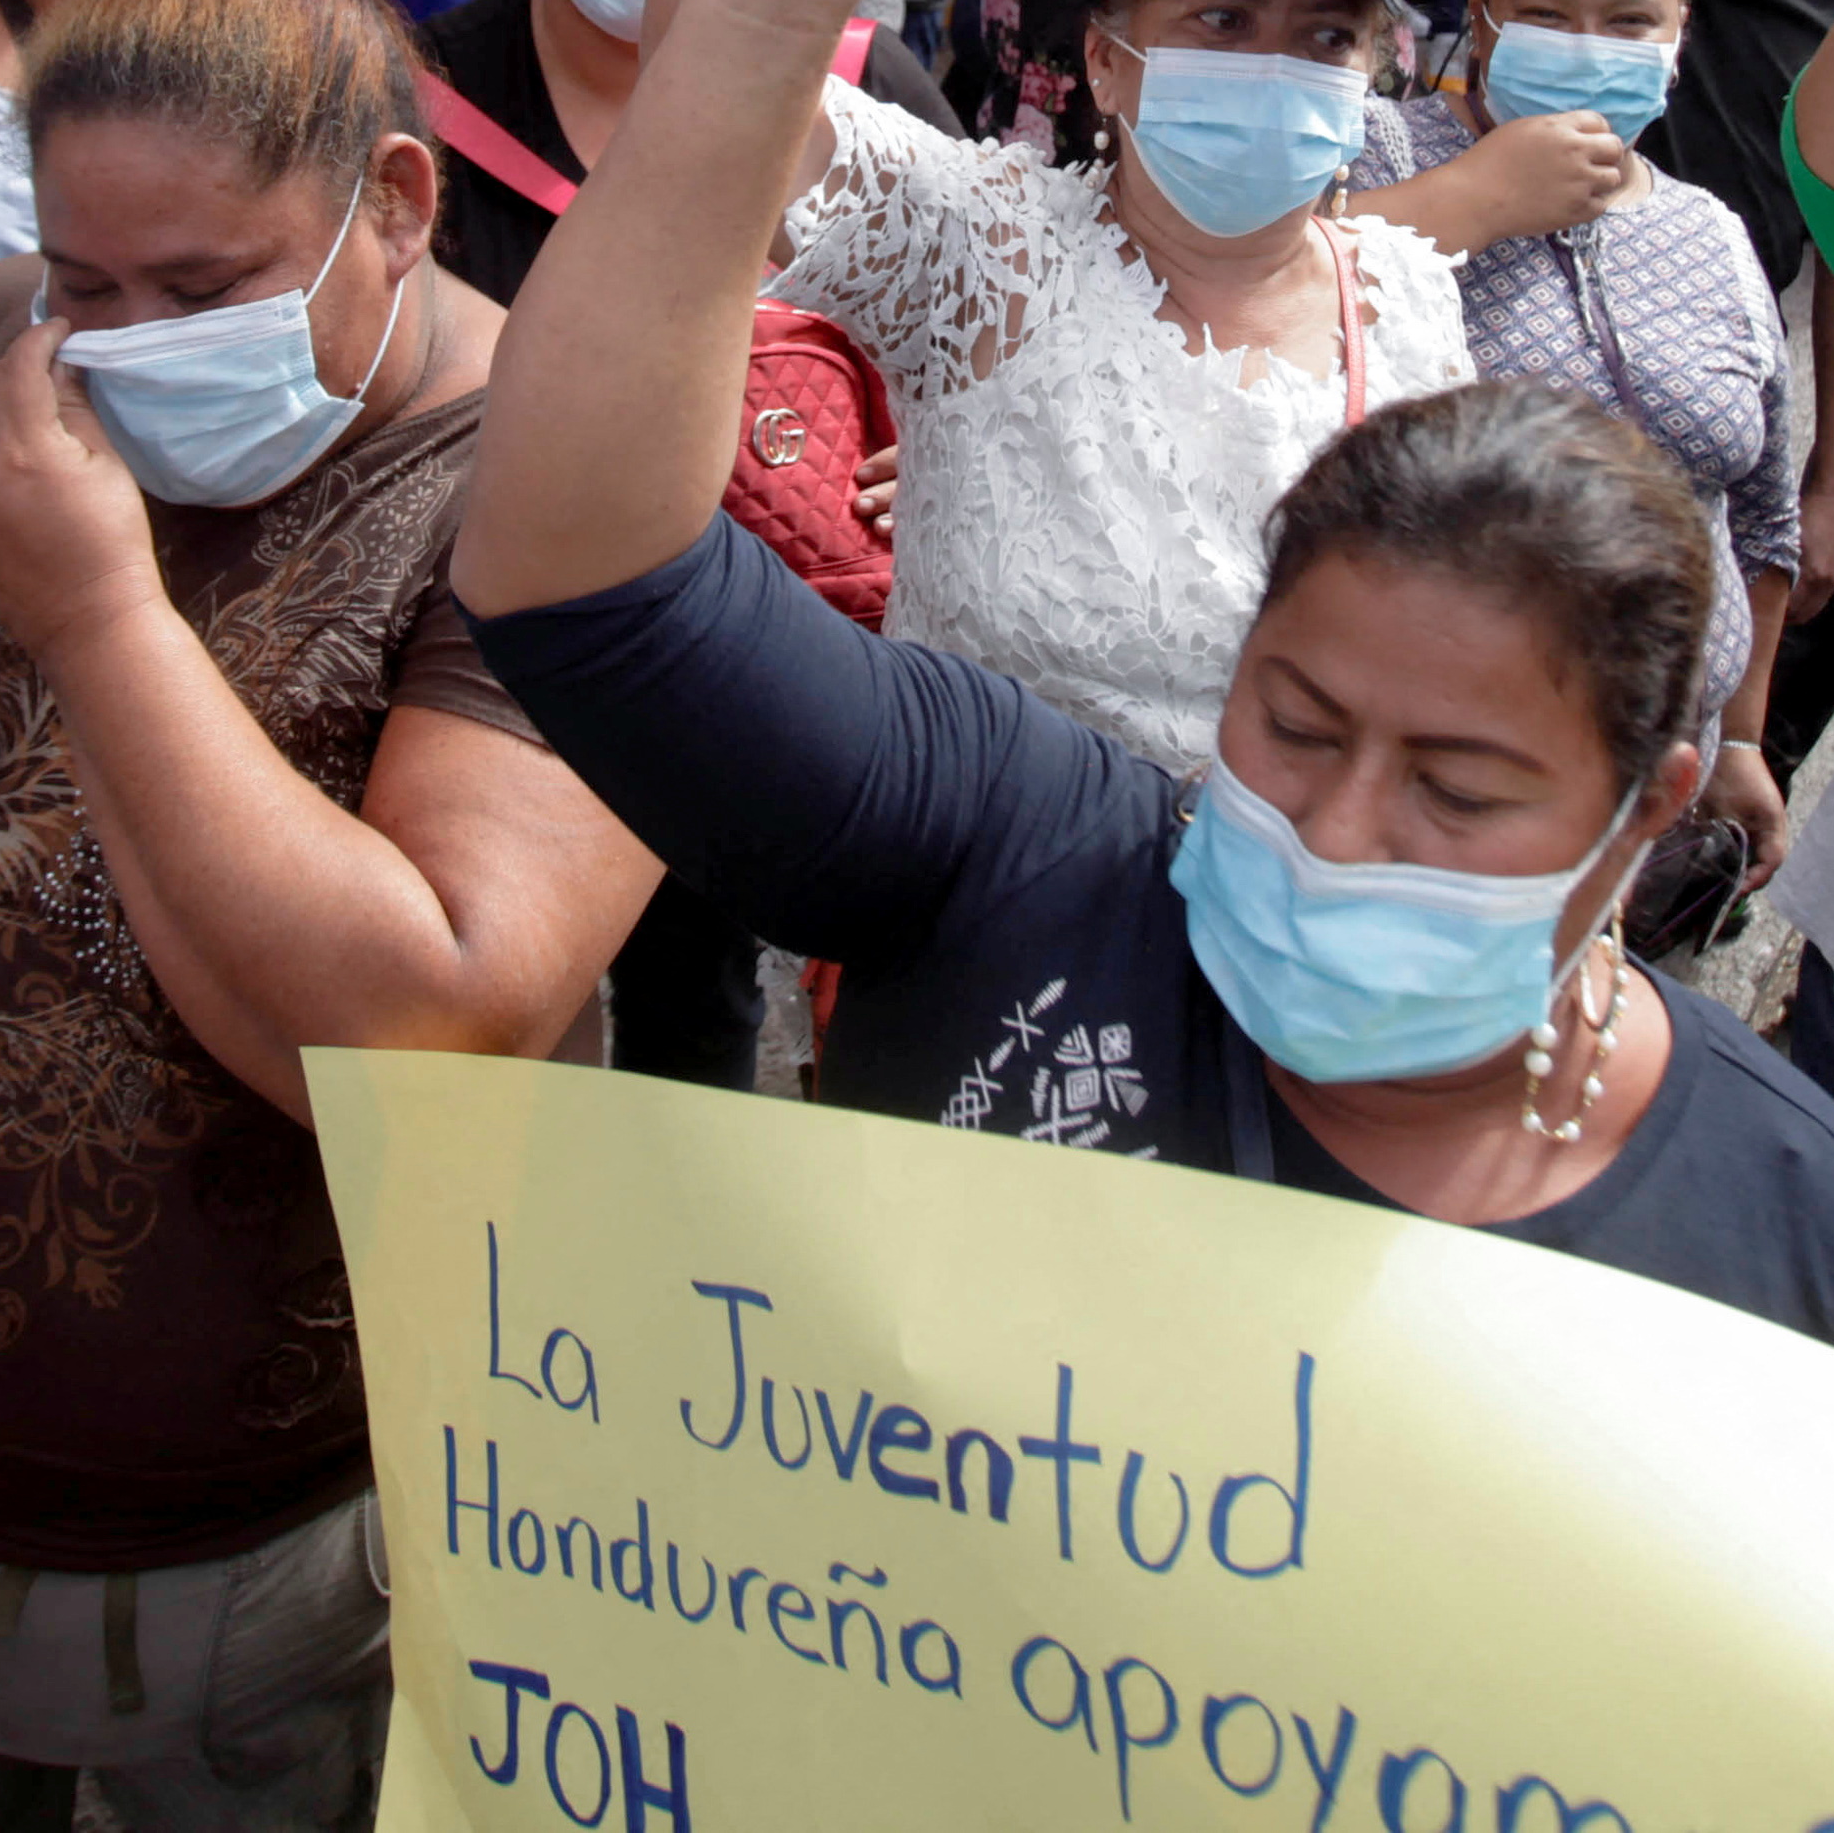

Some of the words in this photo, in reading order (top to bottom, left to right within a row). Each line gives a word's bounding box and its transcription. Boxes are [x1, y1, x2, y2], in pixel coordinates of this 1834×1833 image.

[487, 1220, 600, 1424] La
[679, 1279, 1316, 1580] Juventud
[443, 1425, 964, 1700] Hondureña
[469, 1659, 692, 1833] JOH
